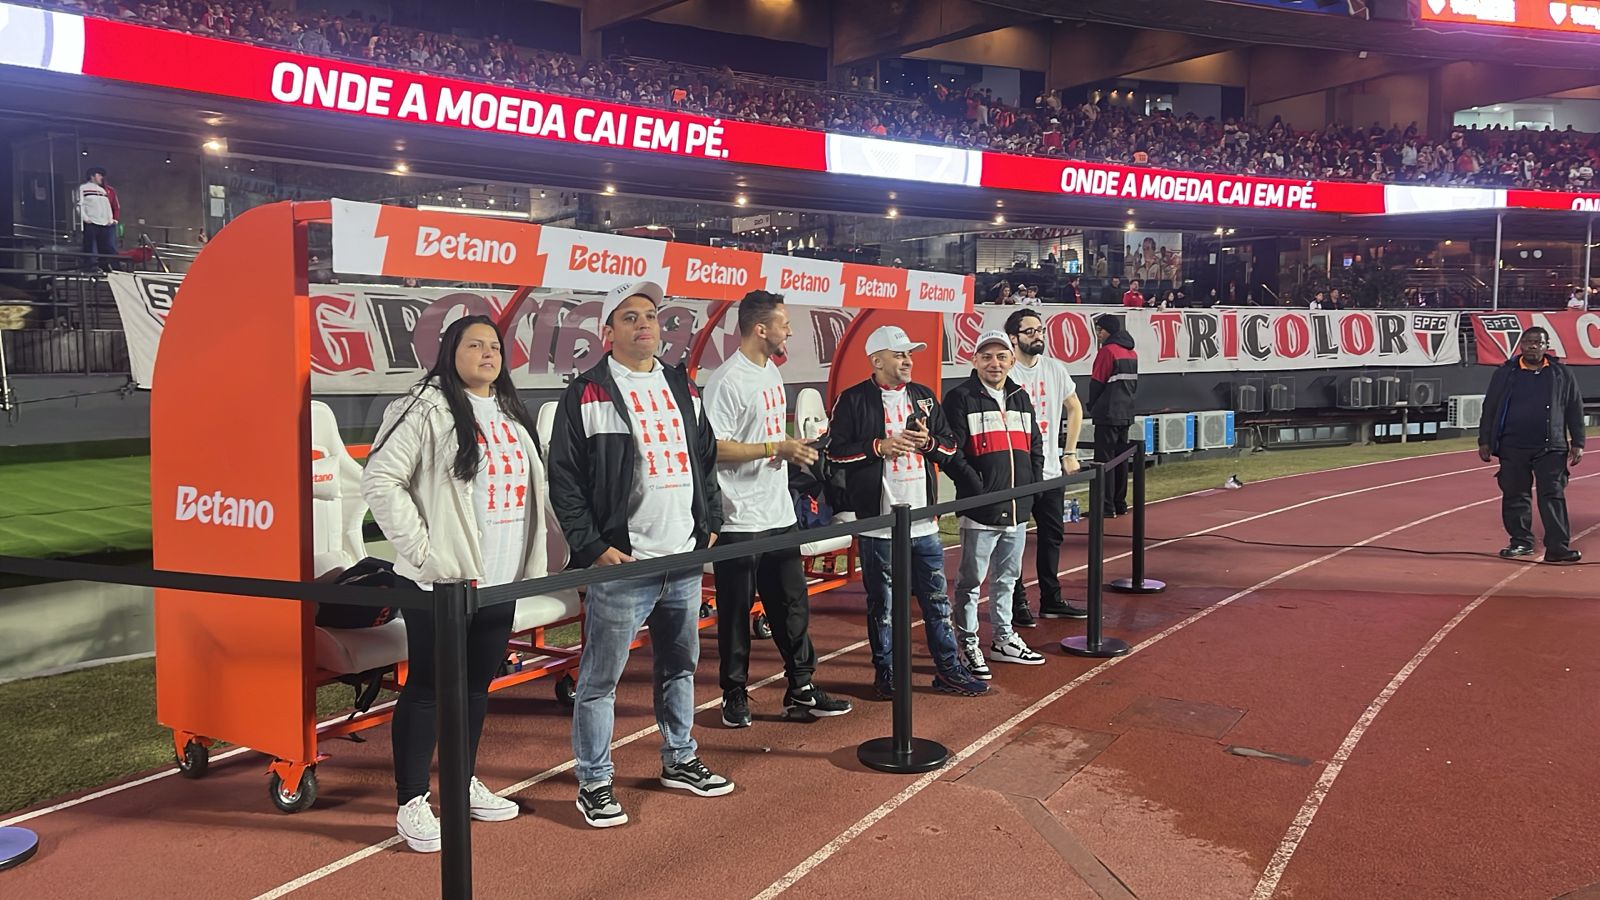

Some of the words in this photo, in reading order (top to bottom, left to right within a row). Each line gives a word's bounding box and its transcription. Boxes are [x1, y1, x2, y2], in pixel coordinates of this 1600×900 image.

[271, 61, 394, 115] ONDE
[397, 83, 428, 120] A
[435, 87, 566, 139] MOEDA
[573, 107, 628, 145] CAI
[633, 116, 680, 152] EM
[685, 119, 729, 158] PÉ.
[1060, 167, 1121, 196] ONDE
[1121, 172, 1137, 198] A
[1140, 174, 1214, 203] MOEDA
[1217, 180, 1252, 205] CAI
[1253, 184, 1285, 207] EM
[1286, 180, 1317, 209] PÉ.
[415, 226, 517, 265] Betano
[568, 245, 647, 277] Betano
[685, 258, 748, 287] Betano
[780, 269, 830, 293] Betano
[855, 276, 898, 298] Betano
[919, 283, 956, 302] Betano
[1150, 310, 1408, 362] TRICOLOR
[1414, 316, 1447, 329] SPFC
[1483, 318, 1519, 329] SPFC
[175, 485, 274, 530] Betano
